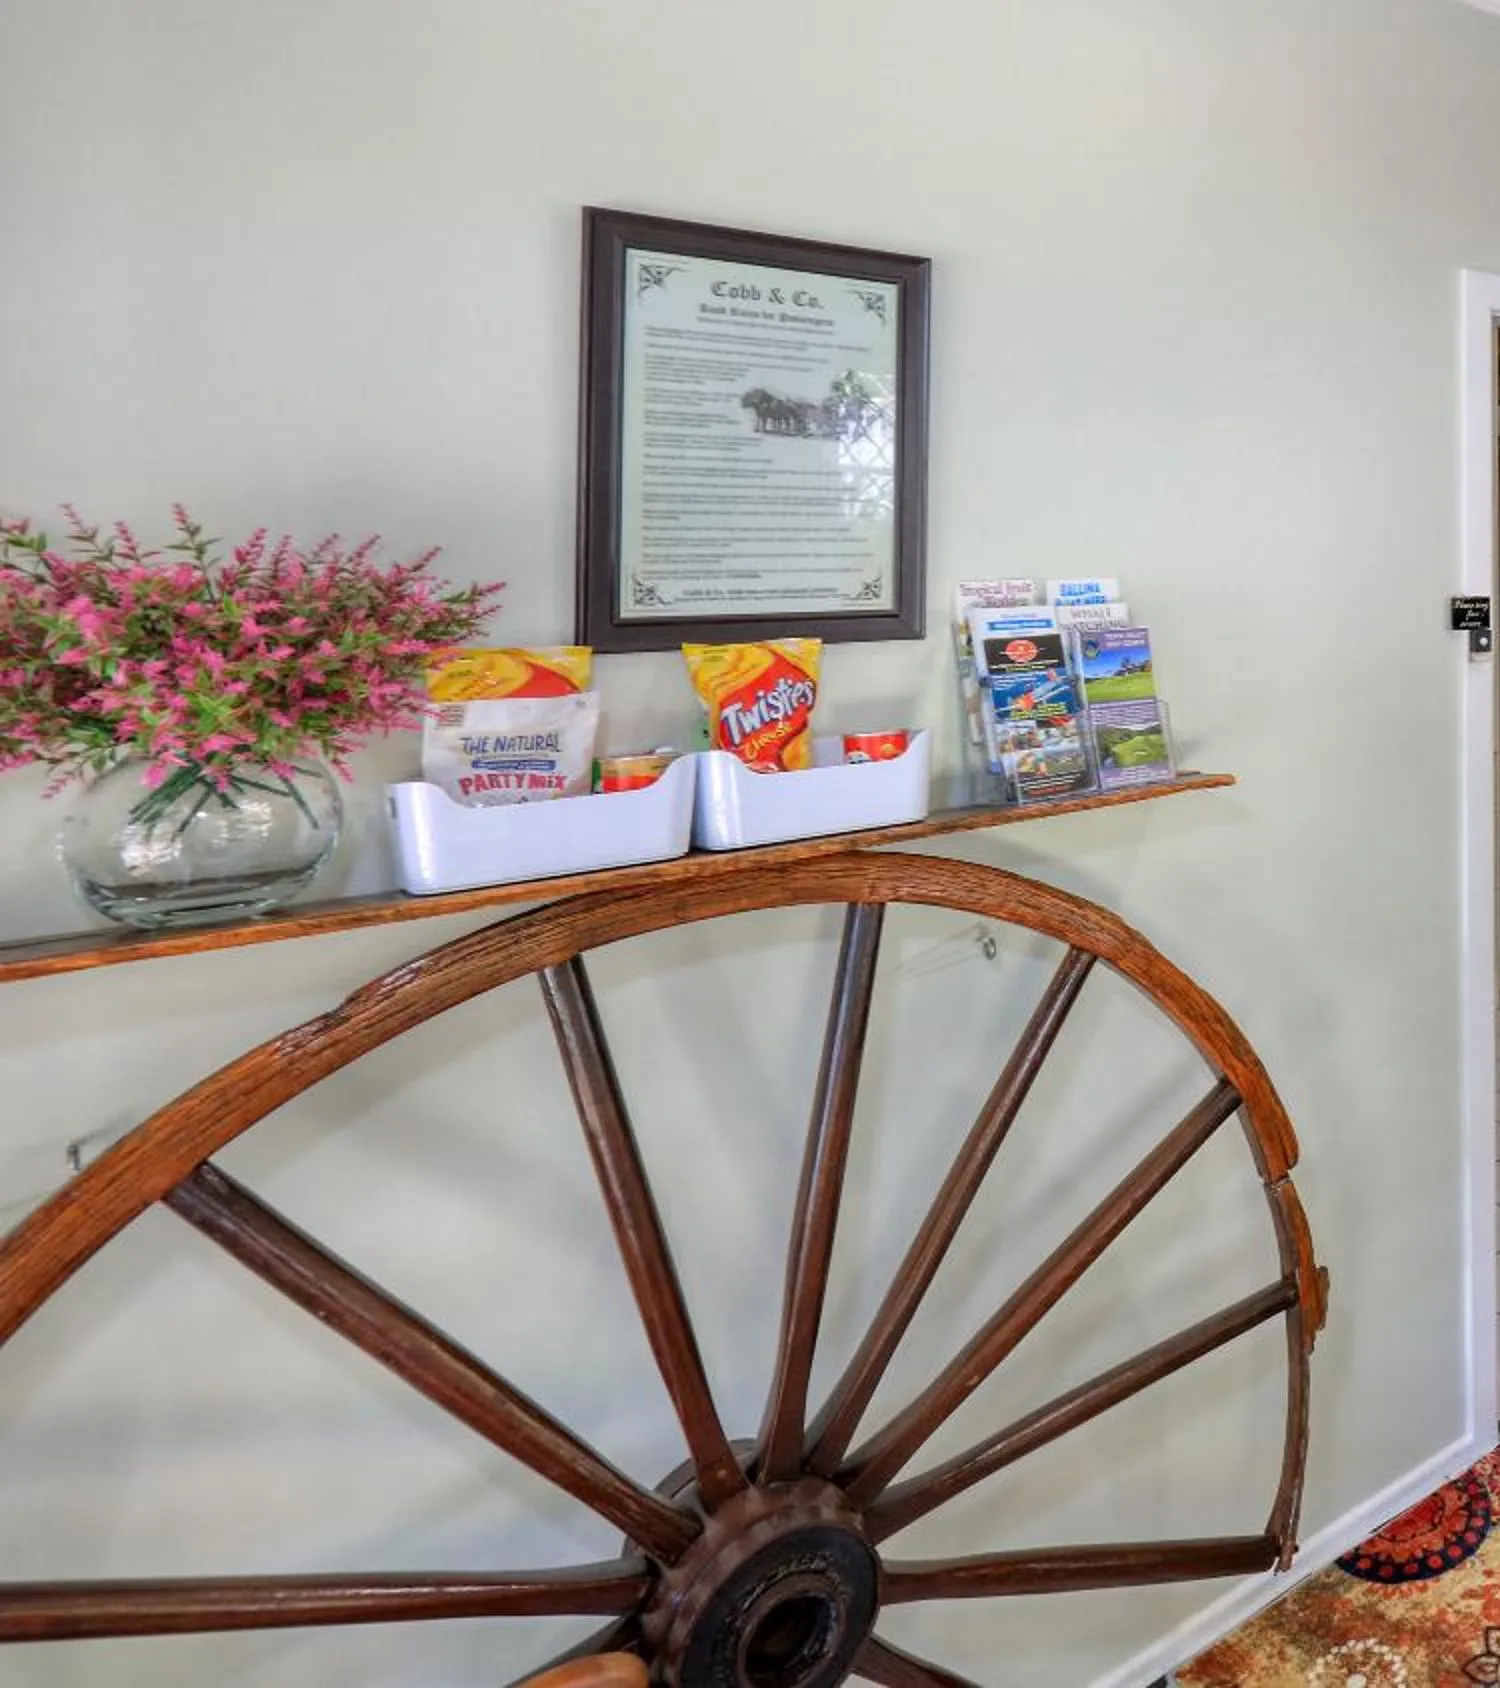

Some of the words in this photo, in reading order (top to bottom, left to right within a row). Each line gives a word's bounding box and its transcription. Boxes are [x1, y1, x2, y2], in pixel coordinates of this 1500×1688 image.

[710, 281, 761, 301] Cobb
[767, 287, 785, 305] &
[720, 676, 816, 746] Twisties
[460, 736, 490, 756] THE
[493, 732, 562, 754] NATURAL
[459, 772, 526, 797] PARTY
